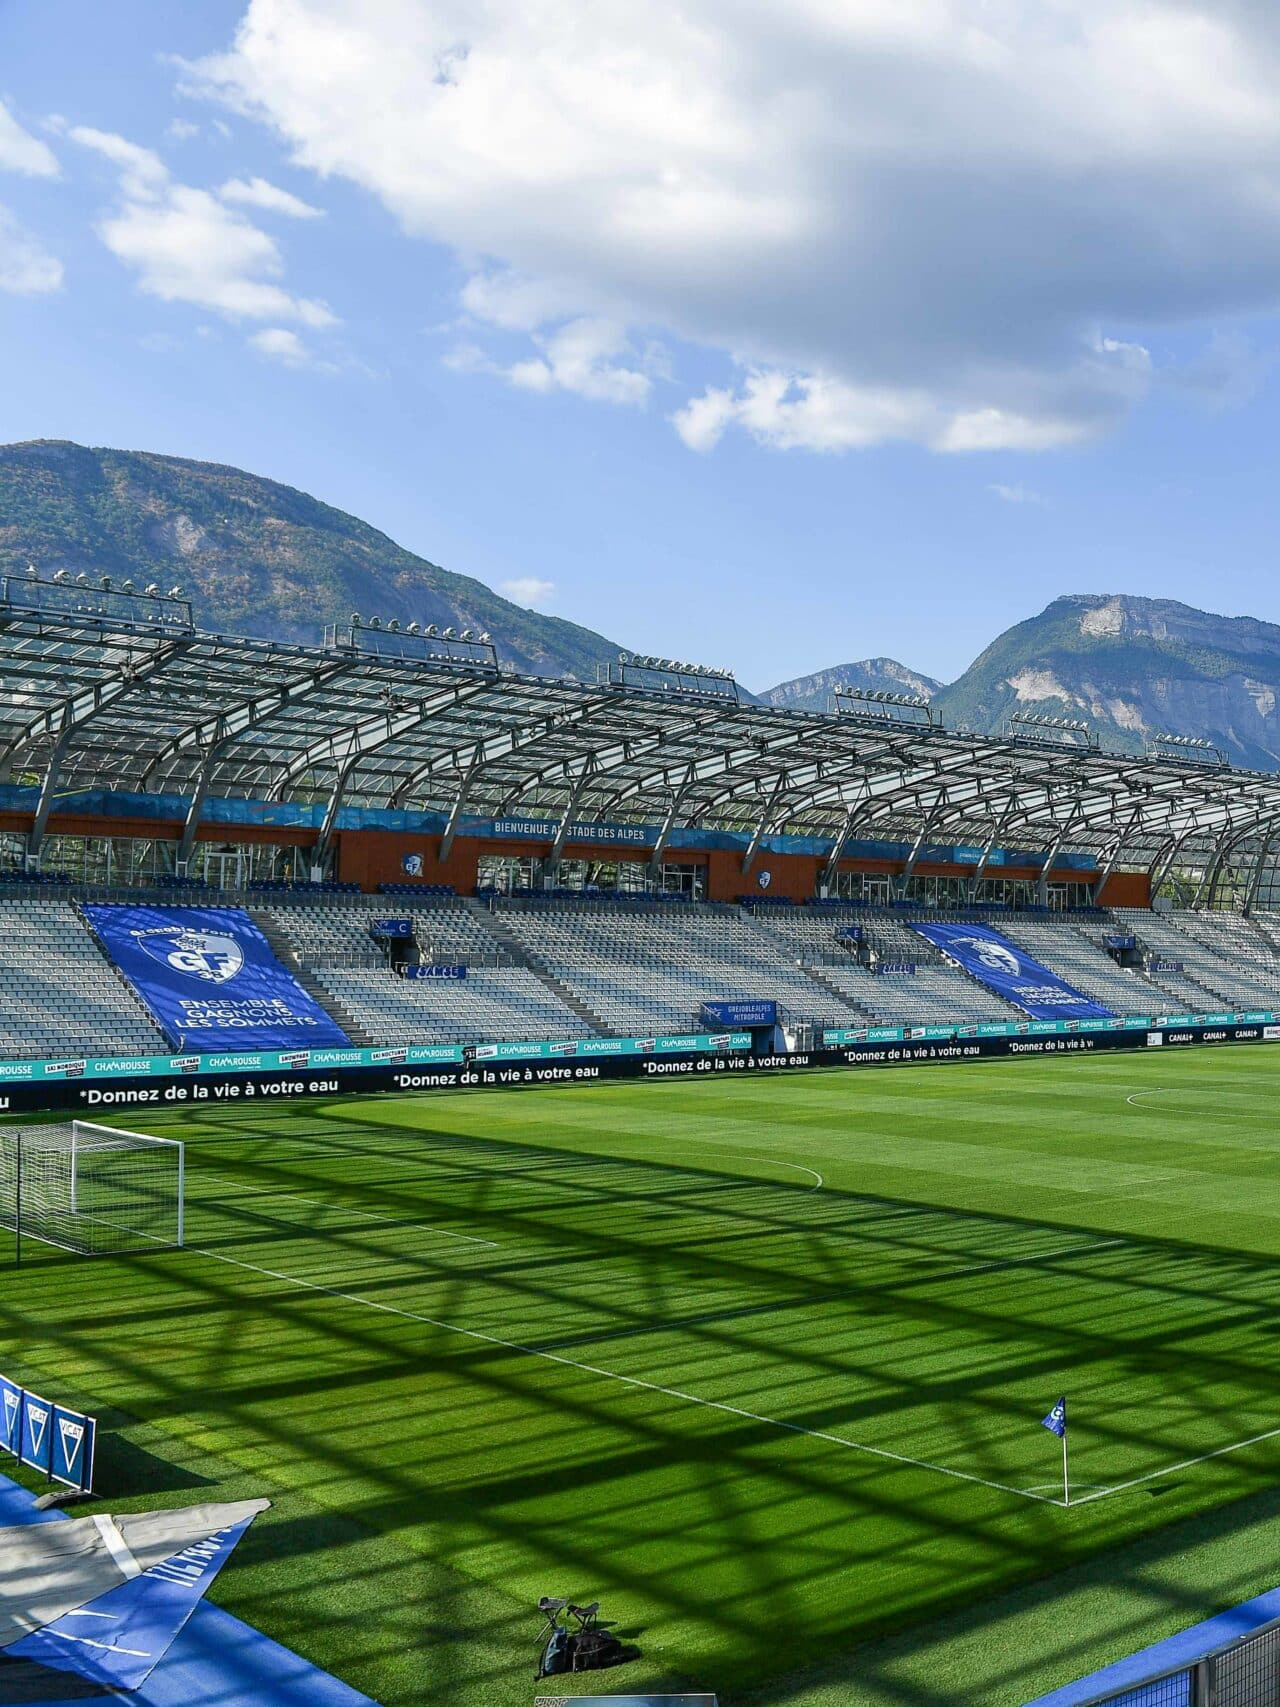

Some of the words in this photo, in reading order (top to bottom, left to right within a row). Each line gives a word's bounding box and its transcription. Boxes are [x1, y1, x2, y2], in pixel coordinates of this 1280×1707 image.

[494, 821, 549, 835] BIENVENUE
[566, 826, 595, 837] STADE
[599, 828, 615, 839] DES
[617, 828, 645, 840] ALPES
[398, 923, 407, 933] C
[166, 949, 230, 972] GF
[416, 966, 459, 978] SAMSE
[178, 999, 286, 1010] ENSEMBLE
[186, 1006, 294, 1019] GAGNONS
[174, 1018, 213, 1029] LES
[218, 1016, 319, 1028] SOMMETS
[1168, 1034, 1194, 1043] CANAL+
[1203, 1031, 1227, 1041] CANAL+
[1235, 1029, 1258, 1039] CANAL+
[1045, 1040, 1056, 1050] de
[1057, 1039, 1065, 1049] la
[1066, 1038, 1078, 1048] vie
[313, 1052, 362, 1063] CHAMROUSSE
[888, 1049, 900, 1059] de
[902, 1048, 911, 1059] la
[913, 1047, 928, 1058] vie
[930, 1046, 936, 1057] à
[938, 1046, 962, 1056] votre
[963, 1045, 980, 1055] eau
[94, 1060, 151, 1072] CHAMROUSSE
[209, 1056, 262, 1067] CHAMROUSSE
[697, 1058, 712, 1071] de
[714, 1057, 725, 1070] la
[728, 1056, 745, 1068] vie
[748, 1055, 755, 1067] à
[757, 1055, 787, 1067] votre
[789, 1055, 809, 1065] eau
[460, 1070, 479, 1085] de
[483, 1069, 496, 1083] la
[500, 1067, 520, 1082] vie
[524, 1066, 532, 1080] à
[536, 1066, 572, 1080] votre
[575, 1066, 599, 1077] eau
[164, 1085, 188, 1100] de
[193, 1084, 208, 1099] la
[214, 1082, 241, 1097] vie
[244, 1080, 255, 1096] à
[260, 1079, 305, 1095] votre
[309, 1079, 338, 1092] eau
[61, 1421, 83, 1440] VICAT
